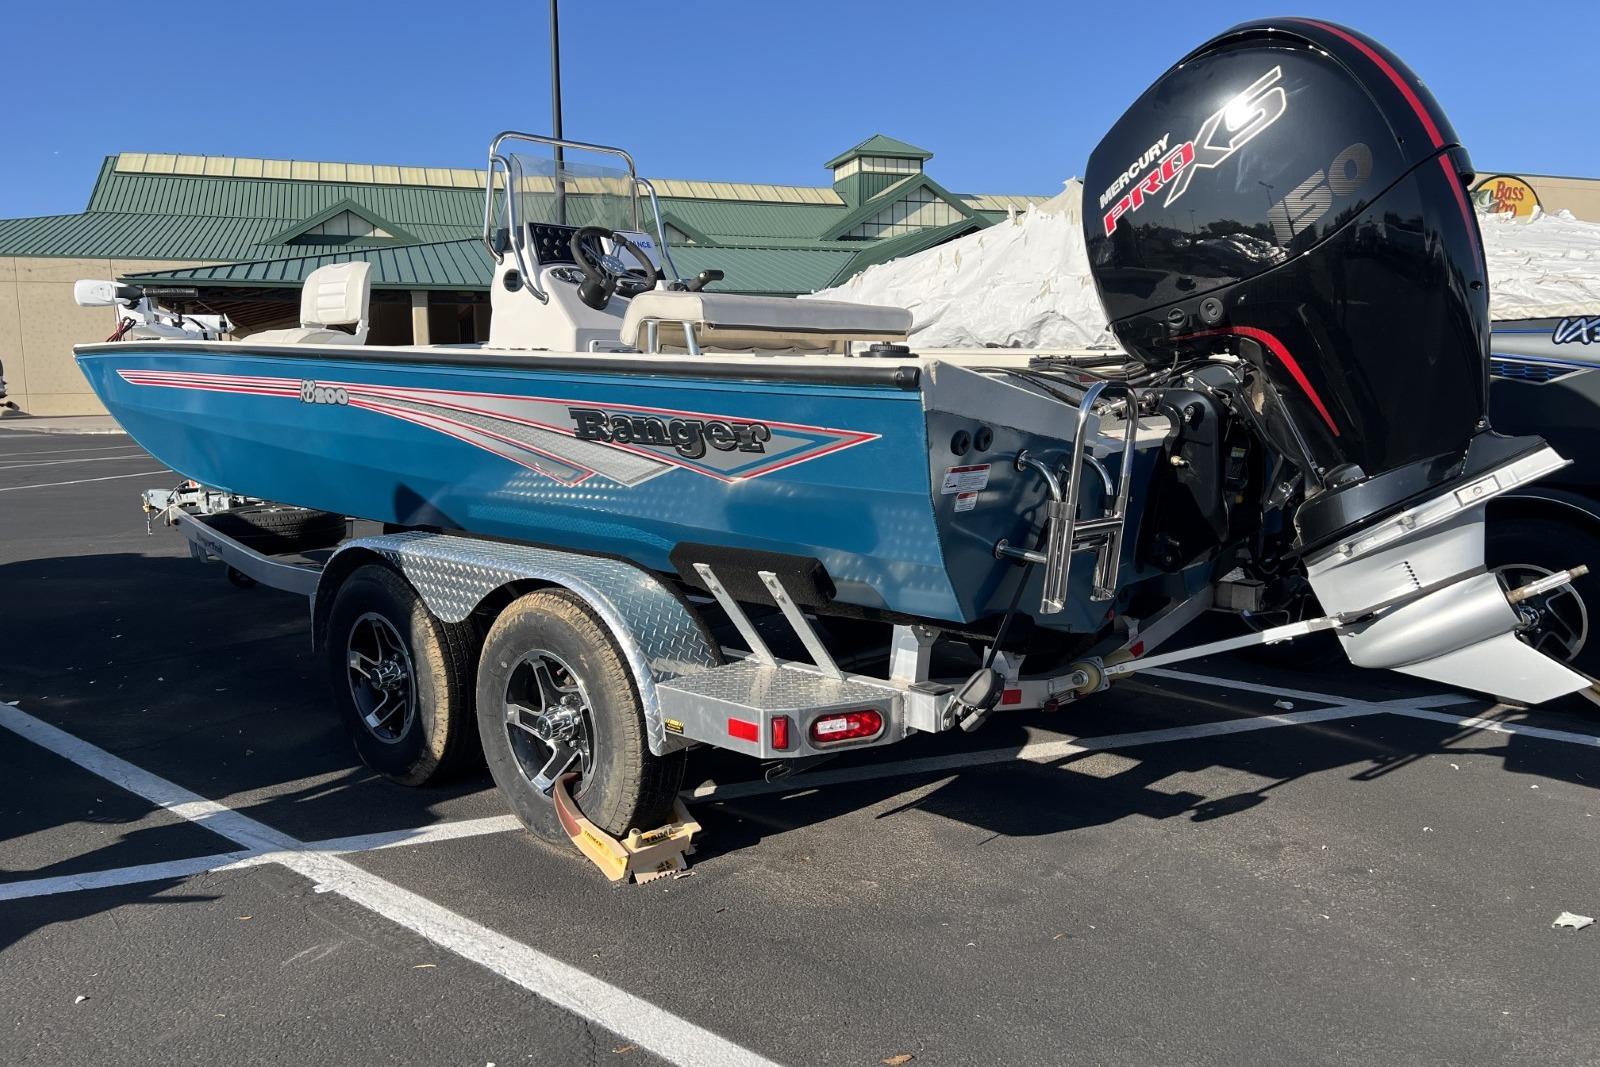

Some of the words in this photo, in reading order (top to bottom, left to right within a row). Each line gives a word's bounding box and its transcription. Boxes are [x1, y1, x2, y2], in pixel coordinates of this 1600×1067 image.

[1099, 132, 1170, 210] MERCURY
[1103, 141, 1195, 238] PRO
[1266, 142, 1373, 248] 150
[1494, 180, 1525, 201] Bass
[567, 407, 772, 460] Ranger
